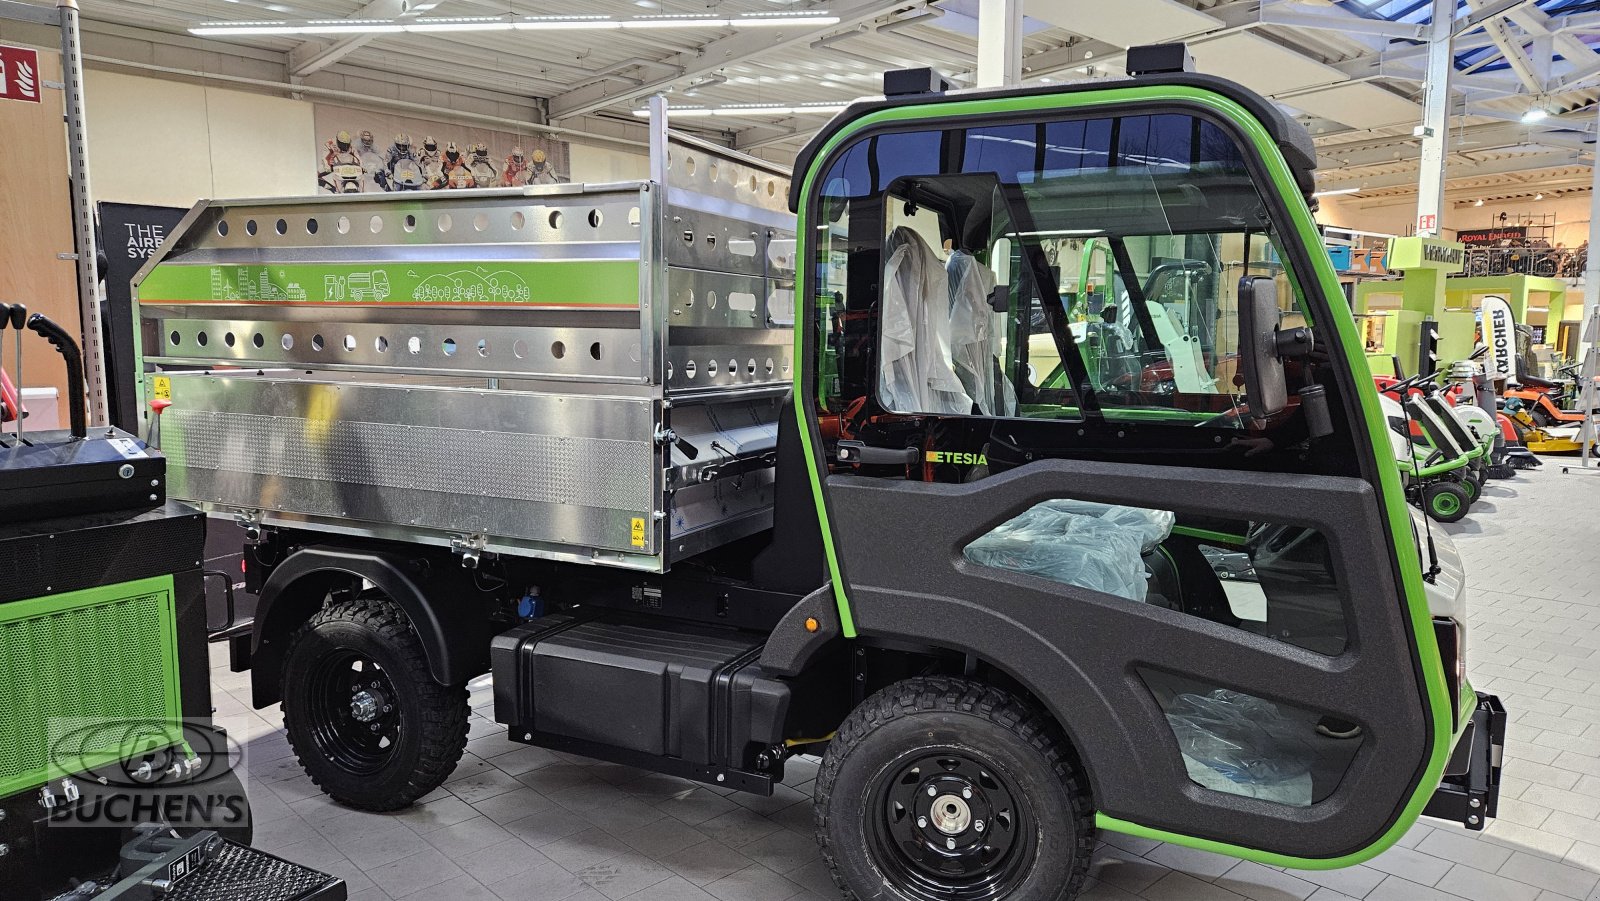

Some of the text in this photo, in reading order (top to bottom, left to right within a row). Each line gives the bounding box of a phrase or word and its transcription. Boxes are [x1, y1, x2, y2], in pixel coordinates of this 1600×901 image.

[124, 223, 164, 238] THE
[1461, 233, 1488, 243] ROYAL
[930, 451, 988, 464] ETESIA
